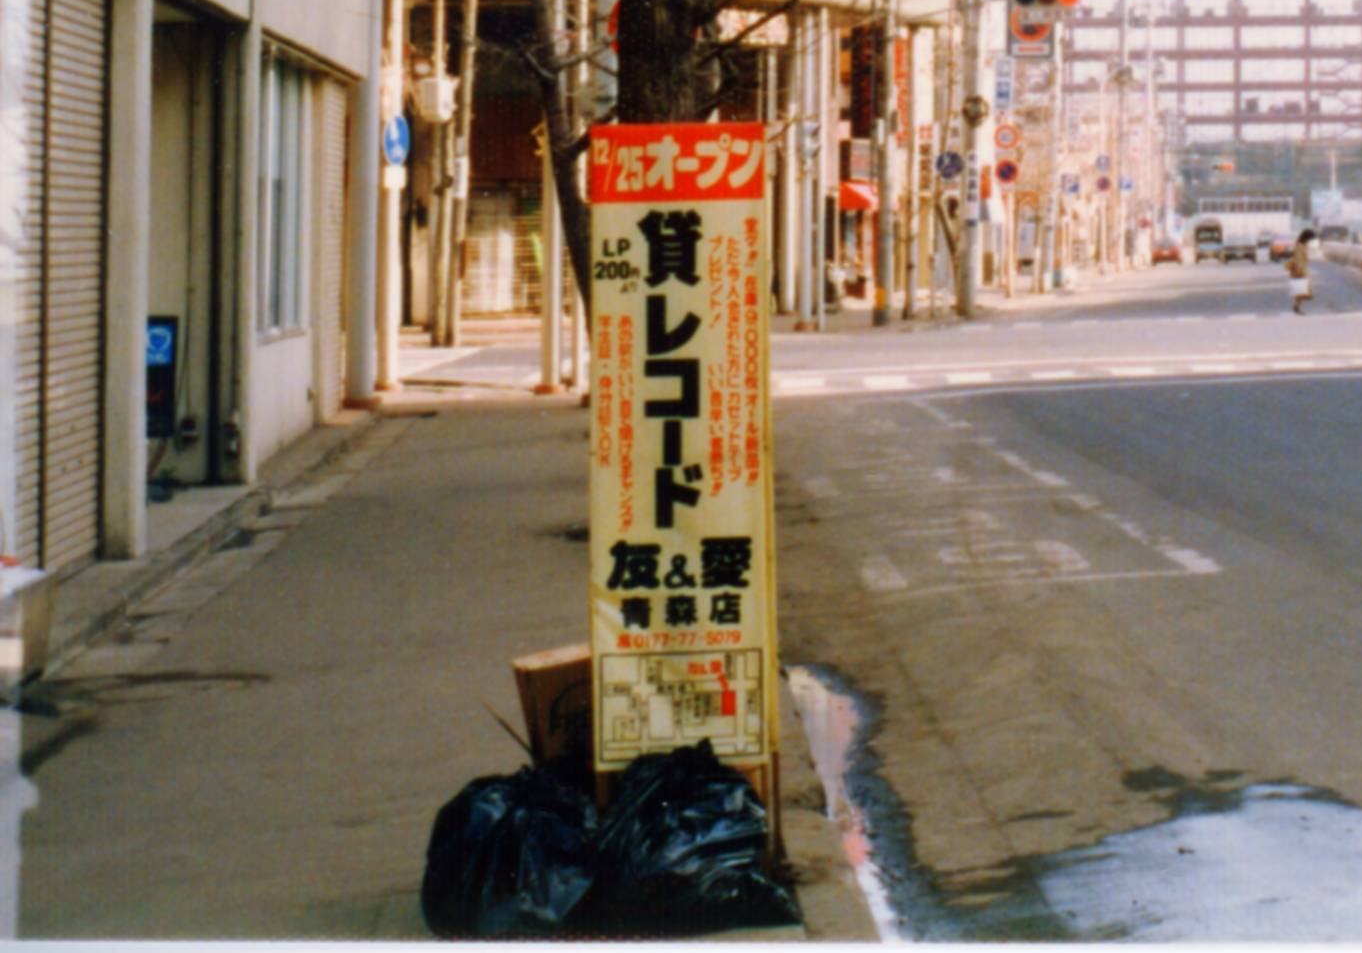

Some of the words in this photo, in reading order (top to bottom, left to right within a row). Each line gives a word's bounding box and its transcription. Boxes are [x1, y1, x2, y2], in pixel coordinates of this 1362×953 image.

[602, 238, 632, 258] LP
[637, 209, 705, 530] 貸レコード
[607, 536, 753, 590] 友&愛
[620, 591, 742, 629] 青森店
